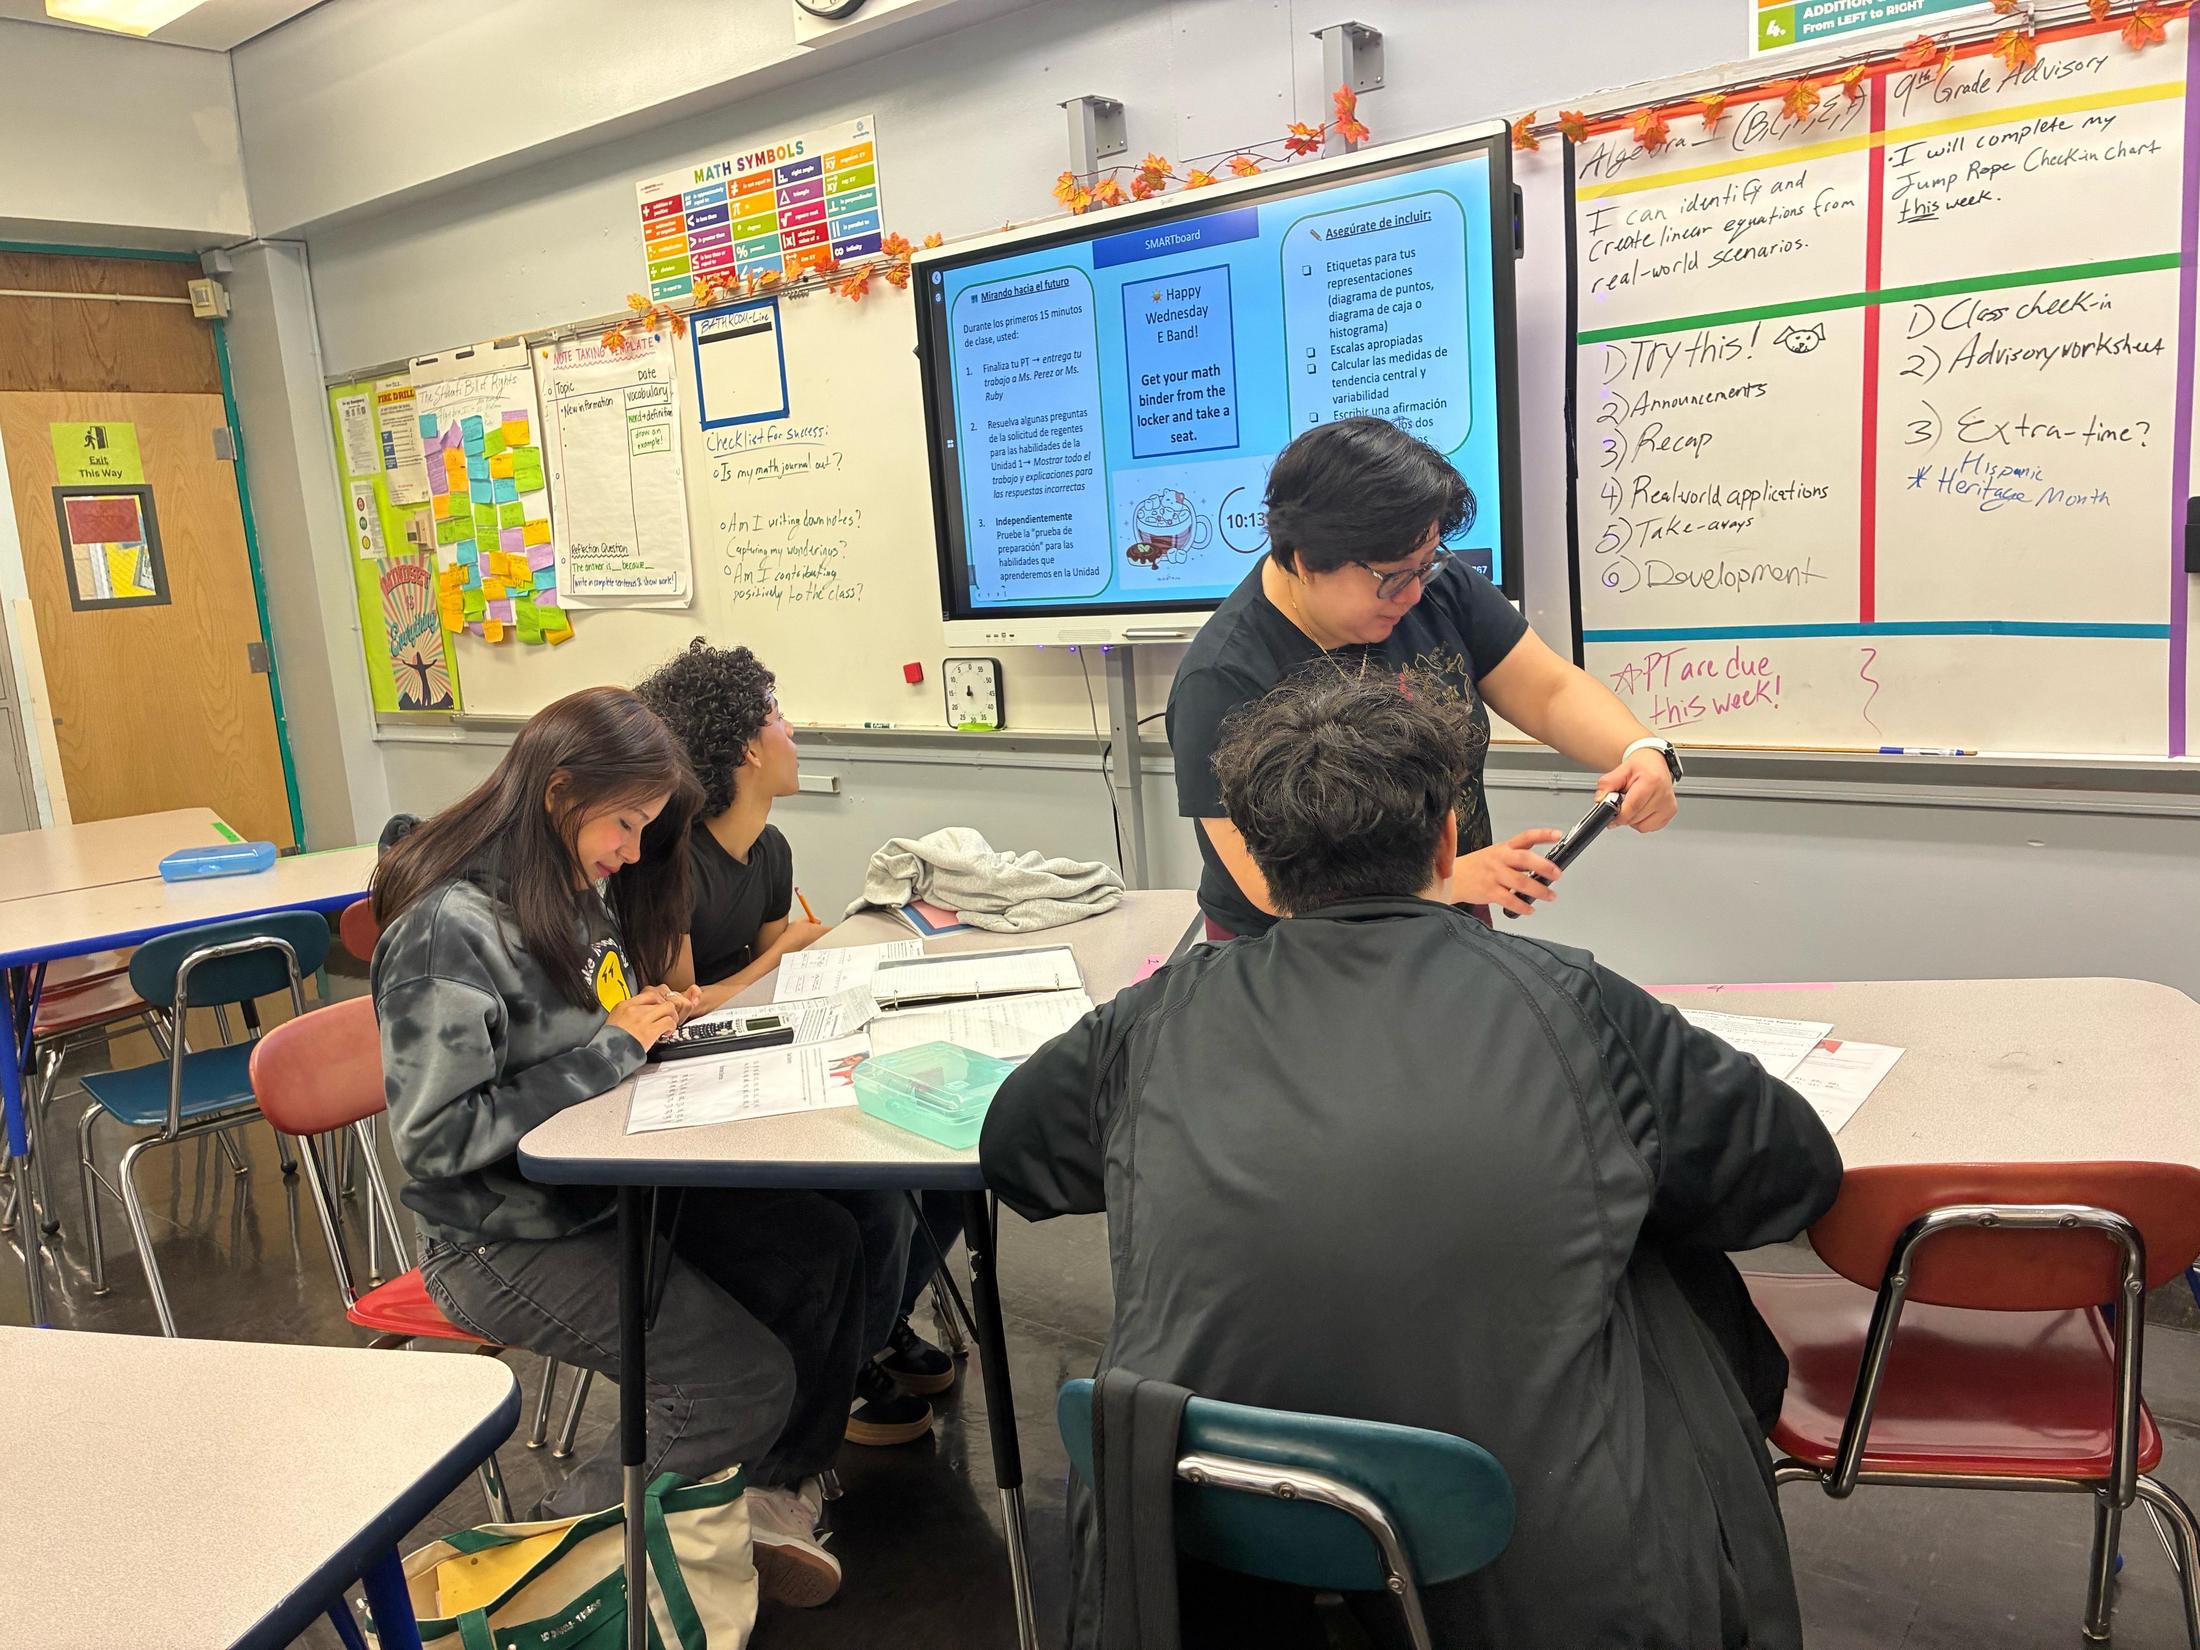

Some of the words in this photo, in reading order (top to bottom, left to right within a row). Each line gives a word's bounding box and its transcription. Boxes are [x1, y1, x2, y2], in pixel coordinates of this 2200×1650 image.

[1766, 20, 1786, 37] 4.
[1803, 21, 1834, 34] From
[1837, 13, 1868, 26] LEFT
[1870, 10, 1883, 19] to
[1886, 0, 1924, 15] RIGHT
[1803, 0, 1872, 19] ADDITION
[1934, 66, 1991, 103] Grade
[1997, 55, 2108, 93] Advisory
[1927, 138, 1964, 158] will
[1976, 117, 2073, 149] complete
[2082, 115, 2117, 132] my
[694, 159, 732, 184] MATH
[737, 140, 804, 171] SYMBOLS
[1892, 171, 1957, 200] Jump
[1967, 161, 2016, 182] Rope
[1586, 206, 1620, 236] I
[1626, 206, 1667, 226] can
[1680, 178, 1762, 216] identify
[1770, 170, 1807, 193] and
[1898, 198, 1939, 222] this
[1946, 190, 2001, 210] week.
[1326, 222, 1376, 239] Asegúrate
[1379, 217, 1392, 228] de
[1395, 210, 1431, 225] incluir:
[1660, 224, 1712, 248] linear
[1723, 204, 1804, 244] equations
[1813, 188, 1856, 218] from
[1145, 229, 1201, 250] SMARTboard
[1327, 256, 1372, 273] Etiquetas
[1375, 253, 1397, 265] para
[1400, 249, 1416, 260] tus
[1592, 252, 1698, 294] real-world
[1708, 238, 1808, 268] scenarios.
[981, 290, 1012, 301] Mirando
[1014, 283, 1034, 296] hacia
[1036, 282, 1043, 291] el
[1044, 277, 1069, 289] futuro
[1327, 266, 1413, 289] representaciones
[1166, 285, 1201, 301] Happy
[1328, 290, 1377, 307] (diagrama
[1380, 287, 1393, 297] de
[1396, 280, 1434, 295] puntos,
[963, 320, 992, 334] Durante
[993, 317, 1004, 328] los
[1005, 312, 1038, 327] primeros
[1040, 310, 1049, 320] 15
[1051, 305, 1082, 318] minutos
[1146, 304, 1209, 324] Wednesday
[1329, 305, 1374, 322] diagrama
[1377, 303, 1389, 314] de
[1393, 301, 1413, 315] caja
[1416, 300, 1422, 308] o
[1942, 298, 2009, 330] Class
[965, 339, 973, 348] de
[975, 334, 995, 346] clase,
[997, 331, 1019, 343] usted:
[1158, 332, 1164, 343] E
[1167, 326, 1199, 342] Band!
[1330, 320, 1388, 338] histograma)
[554, 351, 572, 364] NOTE
[576, 346, 605, 359] TAKING
[1330, 342, 1365, 355] Escalas
[1368, 333, 1423, 352] apropiadas
[1631, 340, 1682, 380] Try
[1685, 321, 1761, 368] this!
[966, 367, 972, 376] 1.
[983, 360, 1009, 373] Finaliza
[1011, 359, 1019, 368] tu
[1020, 357, 1030, 367] PT
[1042, 352, 1071, 366] entrega
[1073, 350, 1082, 359] tu
[1331, 358, 1370, 372] Calcular
[1372, 354, 1386, 366] las
[1389, 349, 1432, 363] medidas
[1435, 347, 1448, 358] de
[1900, 345, 1941, 385] 2)
[638, 368, 656, 381] Date
[1141, 370, 1161, 386] Get
[1163, 370, 1188, 386] your
[1191, 364, 1221, 380] math
[1332, 373, 1380, 388] tendencia
[1383, 367, 1417, 381] central
[1420, 368, 1426, 379] y
[556, 382, 574, 397] Topic
[1139, 391, 1174, 406] binder
[1177, 388, 1203, 403] from
[1207, 385, 1226, 398] the
[1332, 388, 1389, 404] variabilidad
[1372, 405, 1390, 416] una
[1393, 399, 1447, 415] afirmación
[1596, 391, 1630, 425] 2)
[1630, 382, 1768, 418] Announcements
[1137, 413, 1170, 427] locker
[1173, 409, 1193, 422] and
[1196, 406, 1220, 419] take
[1223, 407, 1230, 416] a
[1415, 417, 1433, 428] dos
[1904, 400, 1943, 455] 3)
[1171, 431, 1197, 443] seat.
[1600, 428, 1627, 472] 3)
[1631, 422, 1712, 463] Recap
[89, 455, 109, 466] Exit
[1956, 451, 2044, 481] Hispanic
[78, 468, 100, 478] This
[101, 468, 123, 479] Way
[1601, 477, 1623, 516] 4)
[1726, 480, 1830, 510] applications
[1939, 466, 2034, 512] Heritage
[2035, 486, 2111, 507] Month
[1227, 512, 1265, 528] 10:13
[1595, 517, 1633, 554] 5)
[1601, 555, 1641, 593] 6)
[1645, 556, 1828, 592] Development
[1644, 647, 1688, 692] PT
[1681, 659, 1718, 679] are
[1726, 646, 1774, 679] due
[1650, 694, 1707, 727] this
[1712, 675, 1782, 716] week!
